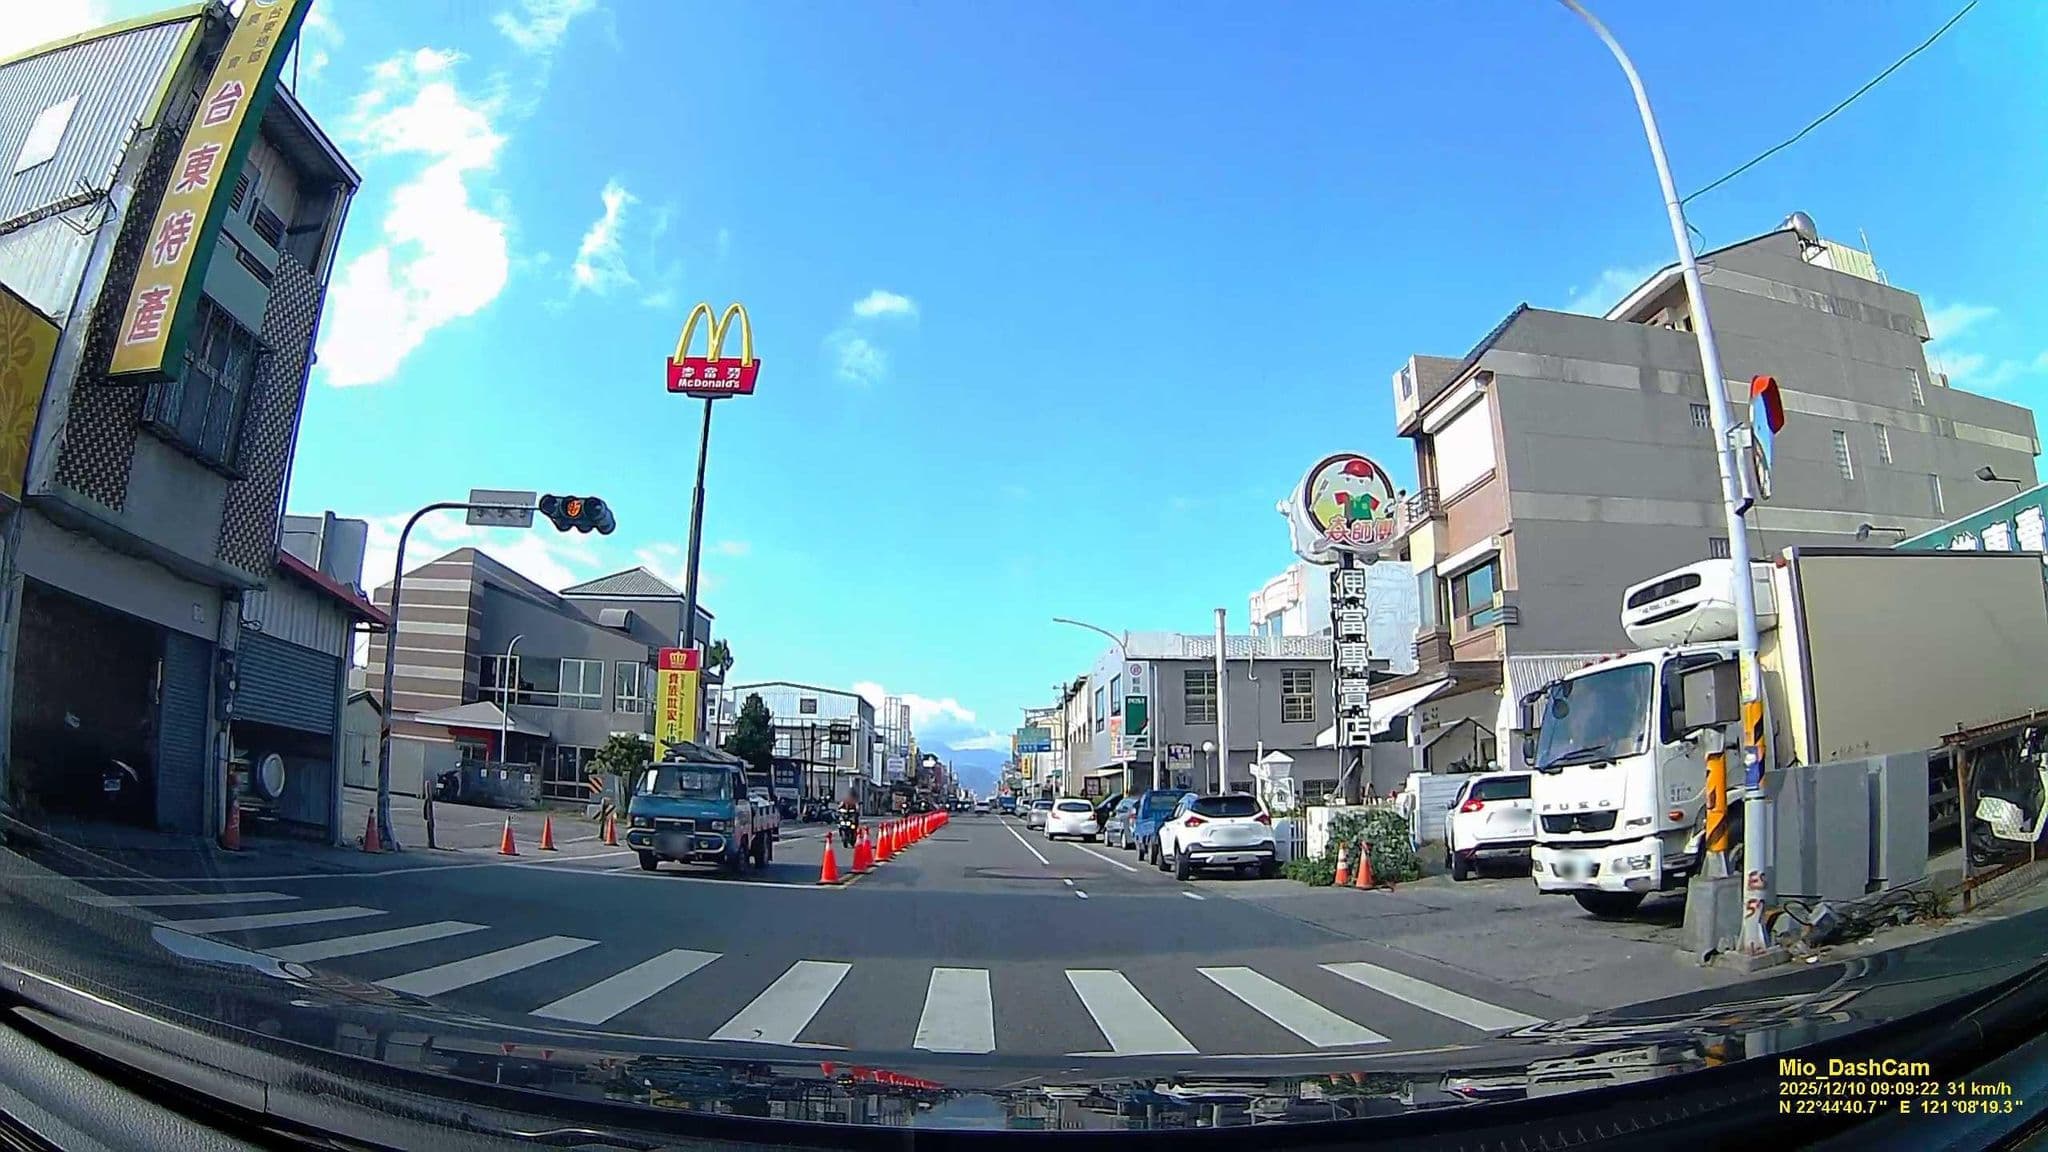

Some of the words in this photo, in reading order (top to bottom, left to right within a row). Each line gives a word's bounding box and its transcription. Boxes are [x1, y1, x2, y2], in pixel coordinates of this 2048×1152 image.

[124, 80, 244, 345] 台東特產
[678, 378, 740, 389] McDonald's
[1335, 567, 1372, 748] 便當專賣店
[1543, 799, 1611, 812] FUSO
